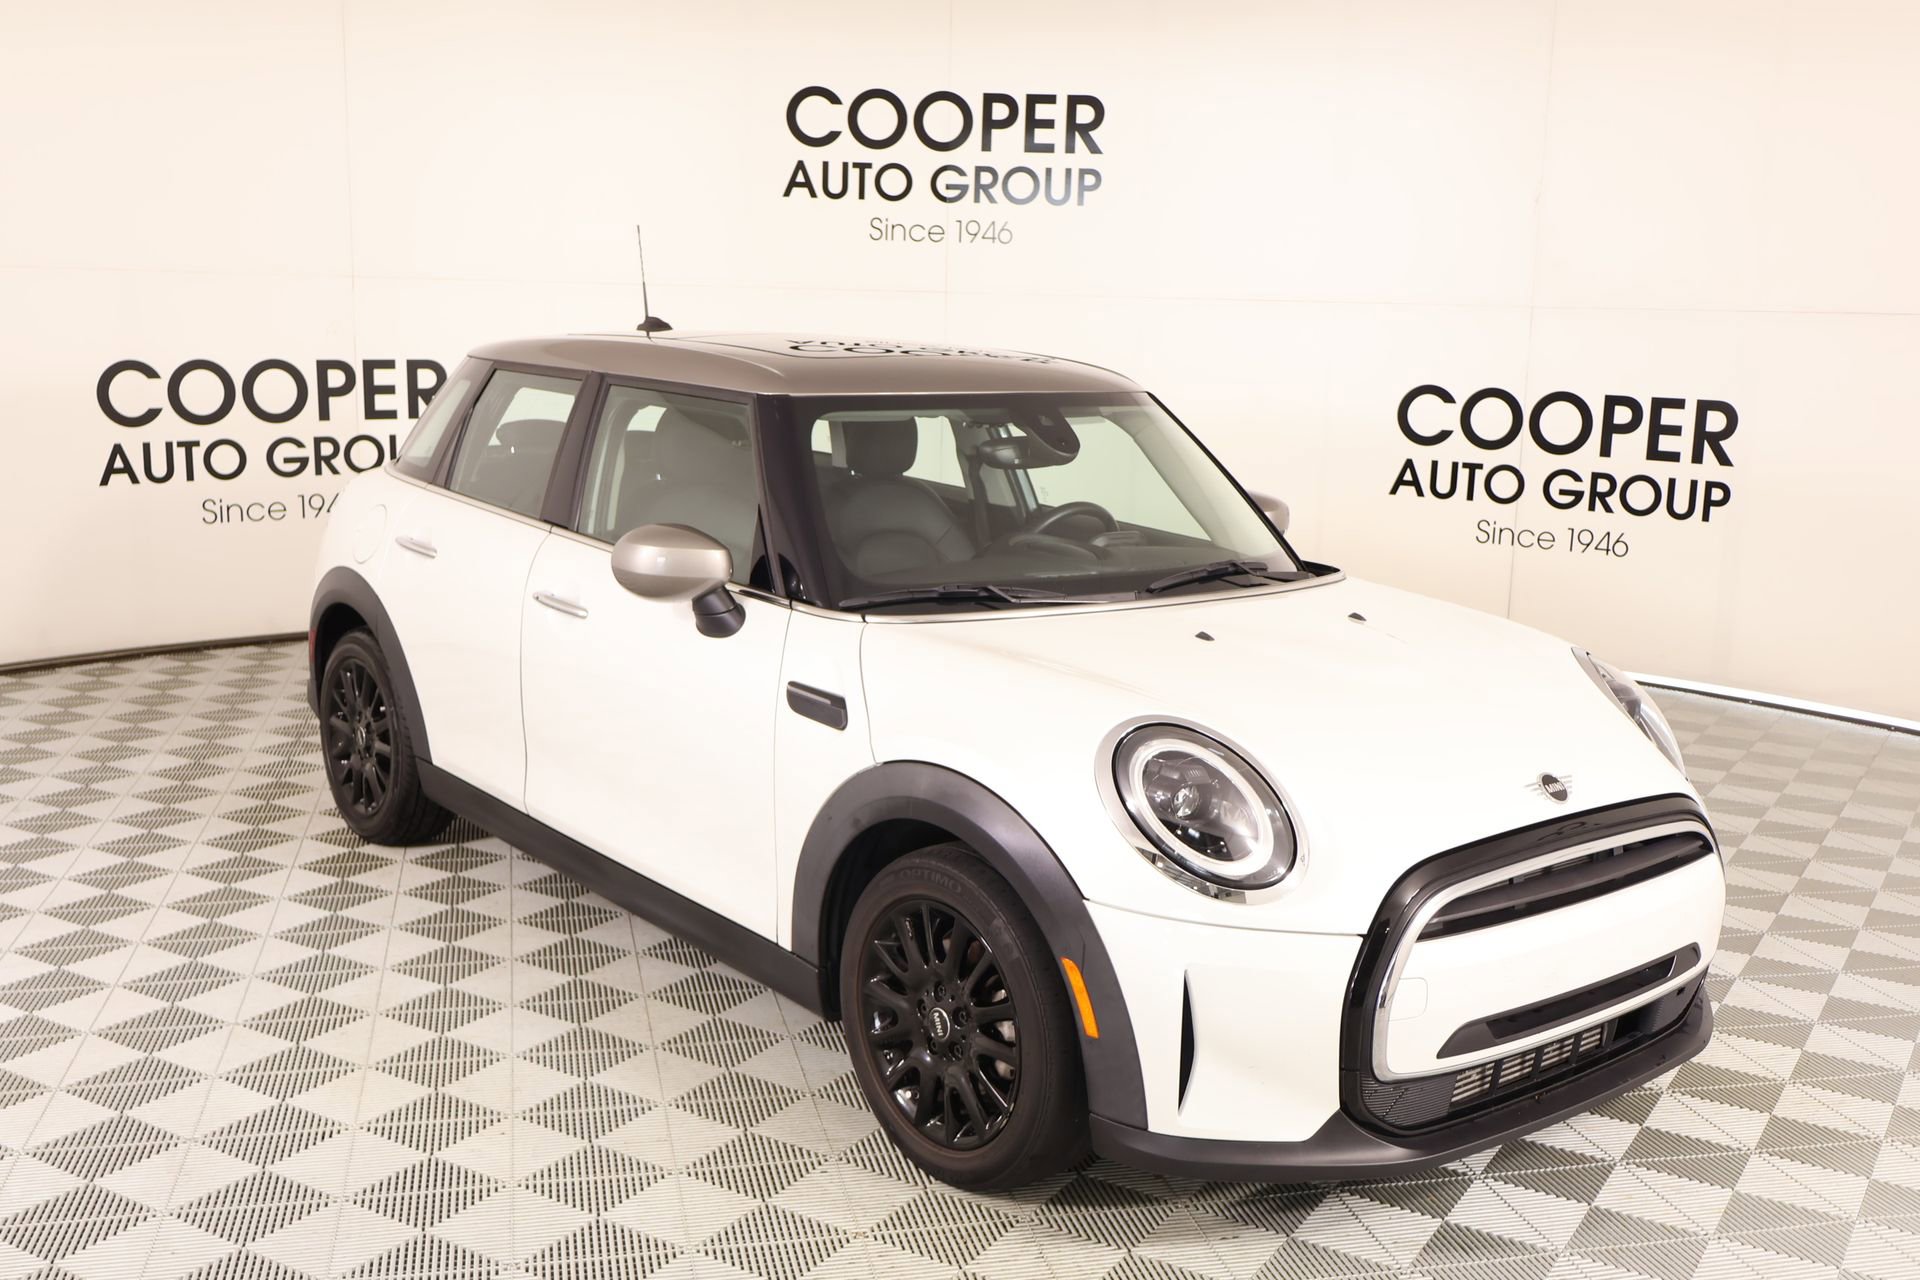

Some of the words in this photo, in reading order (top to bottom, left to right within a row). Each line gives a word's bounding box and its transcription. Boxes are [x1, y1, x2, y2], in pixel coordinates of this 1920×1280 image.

[785, 85, 1106, 155] COOPER
[782, 159, 913, 202] AUTO
[929, 163, 1103, 207] GROUP
[868, 216, 946, 244] Since
[955, 219, 1014, 245] 1946
[96, 358, 448, 428] COOPER
[1396, 384, 1739, 467] COOPER
[99, 438, 248, 487] AUTO
[265, 433, 398, 478] GRO
[201, 498, 288, 525] Since
[1388, 457, 1526, 505] AUTO
[1542, 468, 1732, 523] GROUP
[1475, 519, 1557, 551] Since
[1566, 526, 1630, 558] 1946
[1545, 781, 1565, 793] MINI
[898, 867, 964, 894] OPTIMO
[933, 1012, 944, 1036] MINI
